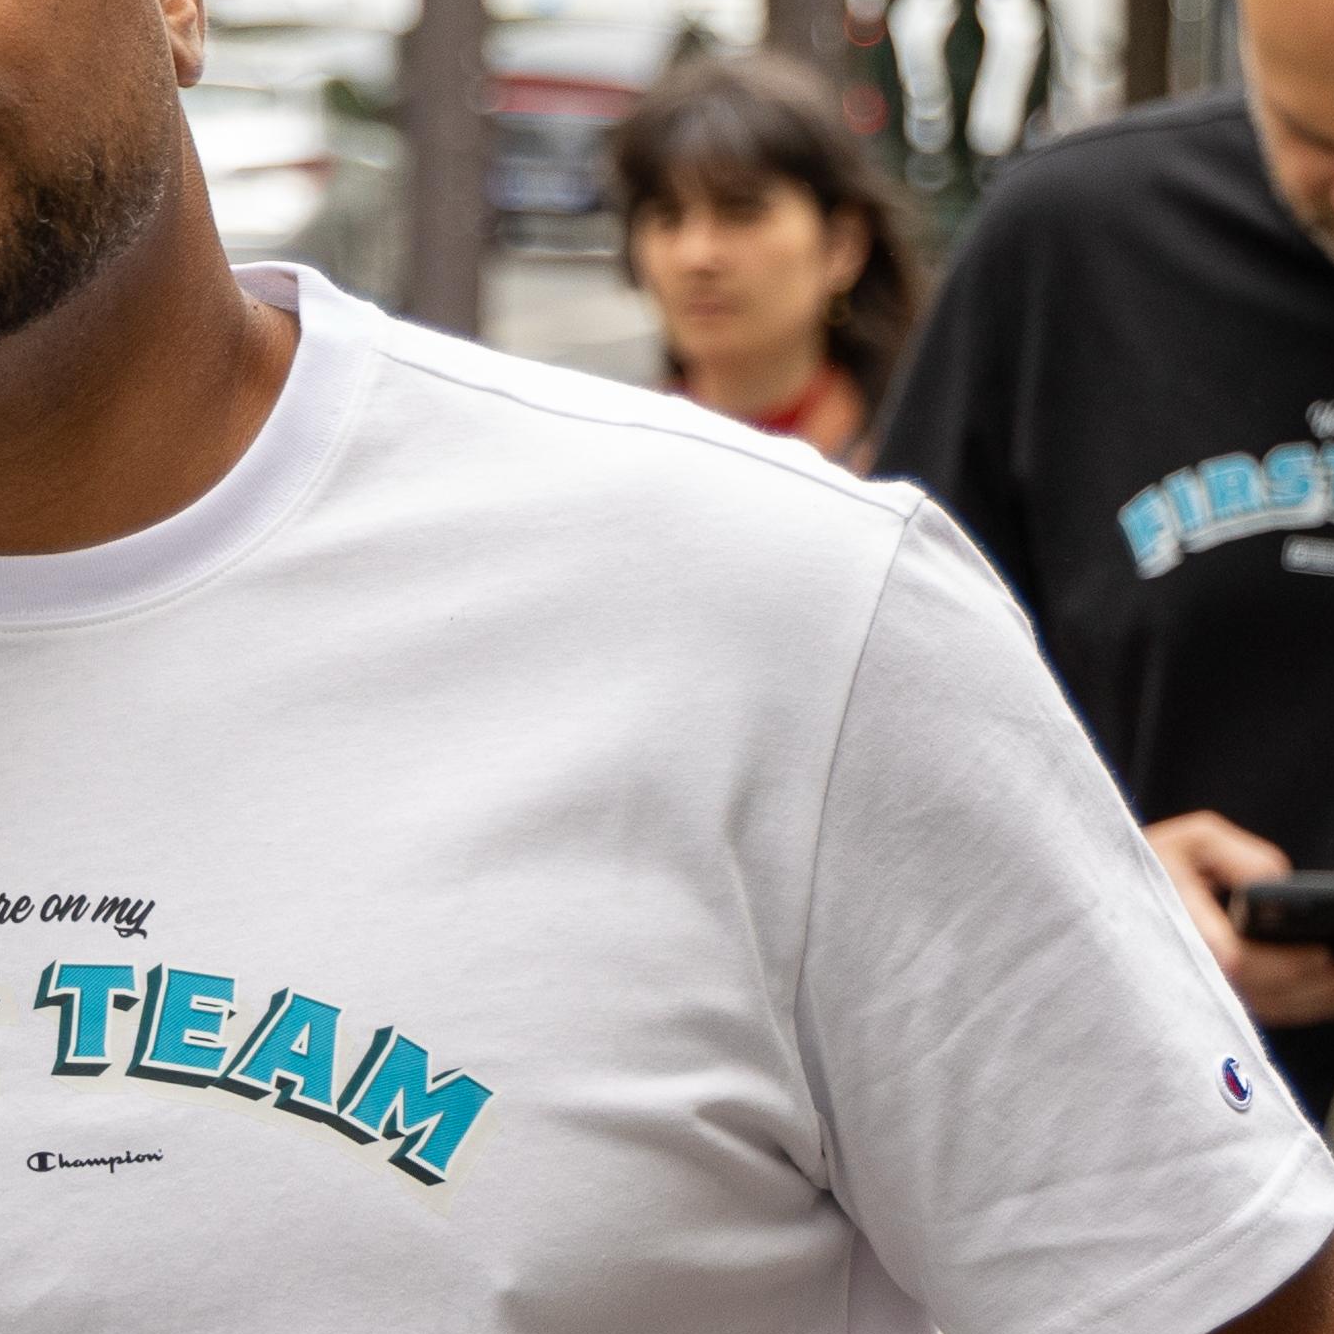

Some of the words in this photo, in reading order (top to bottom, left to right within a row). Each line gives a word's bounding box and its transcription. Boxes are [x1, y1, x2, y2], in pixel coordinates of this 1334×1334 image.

[40, 894, 90, 922] on
[92, 895, 155, 939] my
[35, 961, 496, 1186] TEAM
[26, 1149, 163, 1174] Champion
